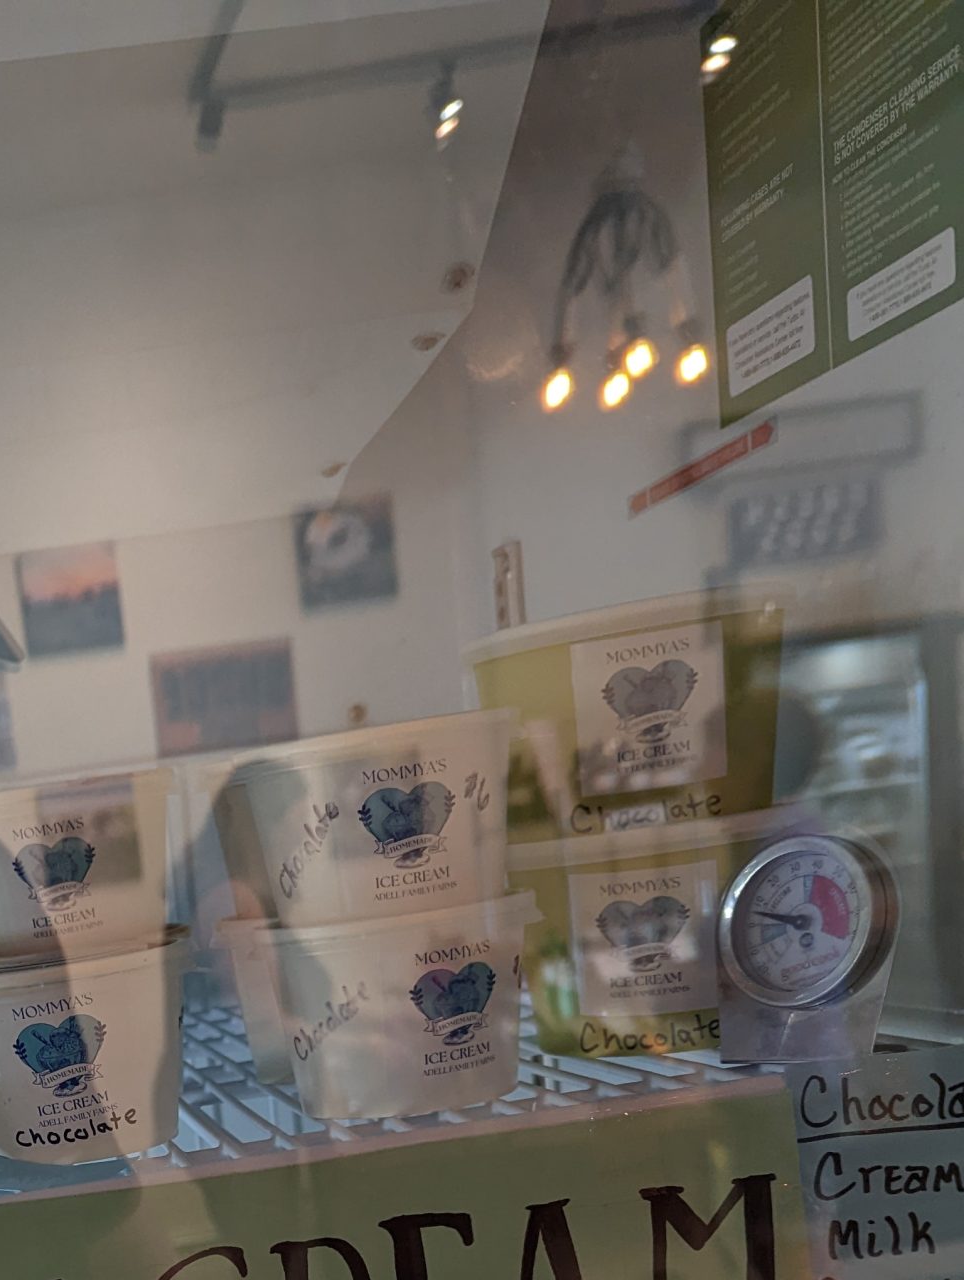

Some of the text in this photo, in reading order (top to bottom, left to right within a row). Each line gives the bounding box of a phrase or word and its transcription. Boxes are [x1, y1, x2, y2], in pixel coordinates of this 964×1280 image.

[846, 105, 888, 142] CONDENSER
[888, 70, 926, 108] CLEANING
[926, 44, 962, 83] SERVICE
[856, 116, 889, 148] COVERED
[916, 61, 960, 103] WARRANTY
[605, 638, 690, 665] MOMMYA'S
[616, 740, 691, 764] ICE CREAM
[362, 758, 447, 786] MOMMYA'S
[12, 817, 85, 841] MOMMYA'S
[375, 866, 450, 889] ICE CREAM
[598, 876, 681, 897] MOMMYA'S
[32, 907, 96, 929] ICE CREAM
[415, 939, 491, 966] MOMMYA'S
[610, 972, 682, 989] ICE CREAM
[12, 993, 93, 1021] MOMMYA'S
[580, 1014, 720, 1053] Chocolate
[424, 1041, 491, 1065] ICE CREAM
[46, 1065, 88, 1085] HOMEMADE
[38, 1090, 109, 1117] ICE CREAM
[16, 1108, 137, 1147] Chocolate
[38, 1117, 63, 1129] ADELL
[63, 1110, 92, 1124] FAMILY
[828, 1211, 936, 1260] Milk
